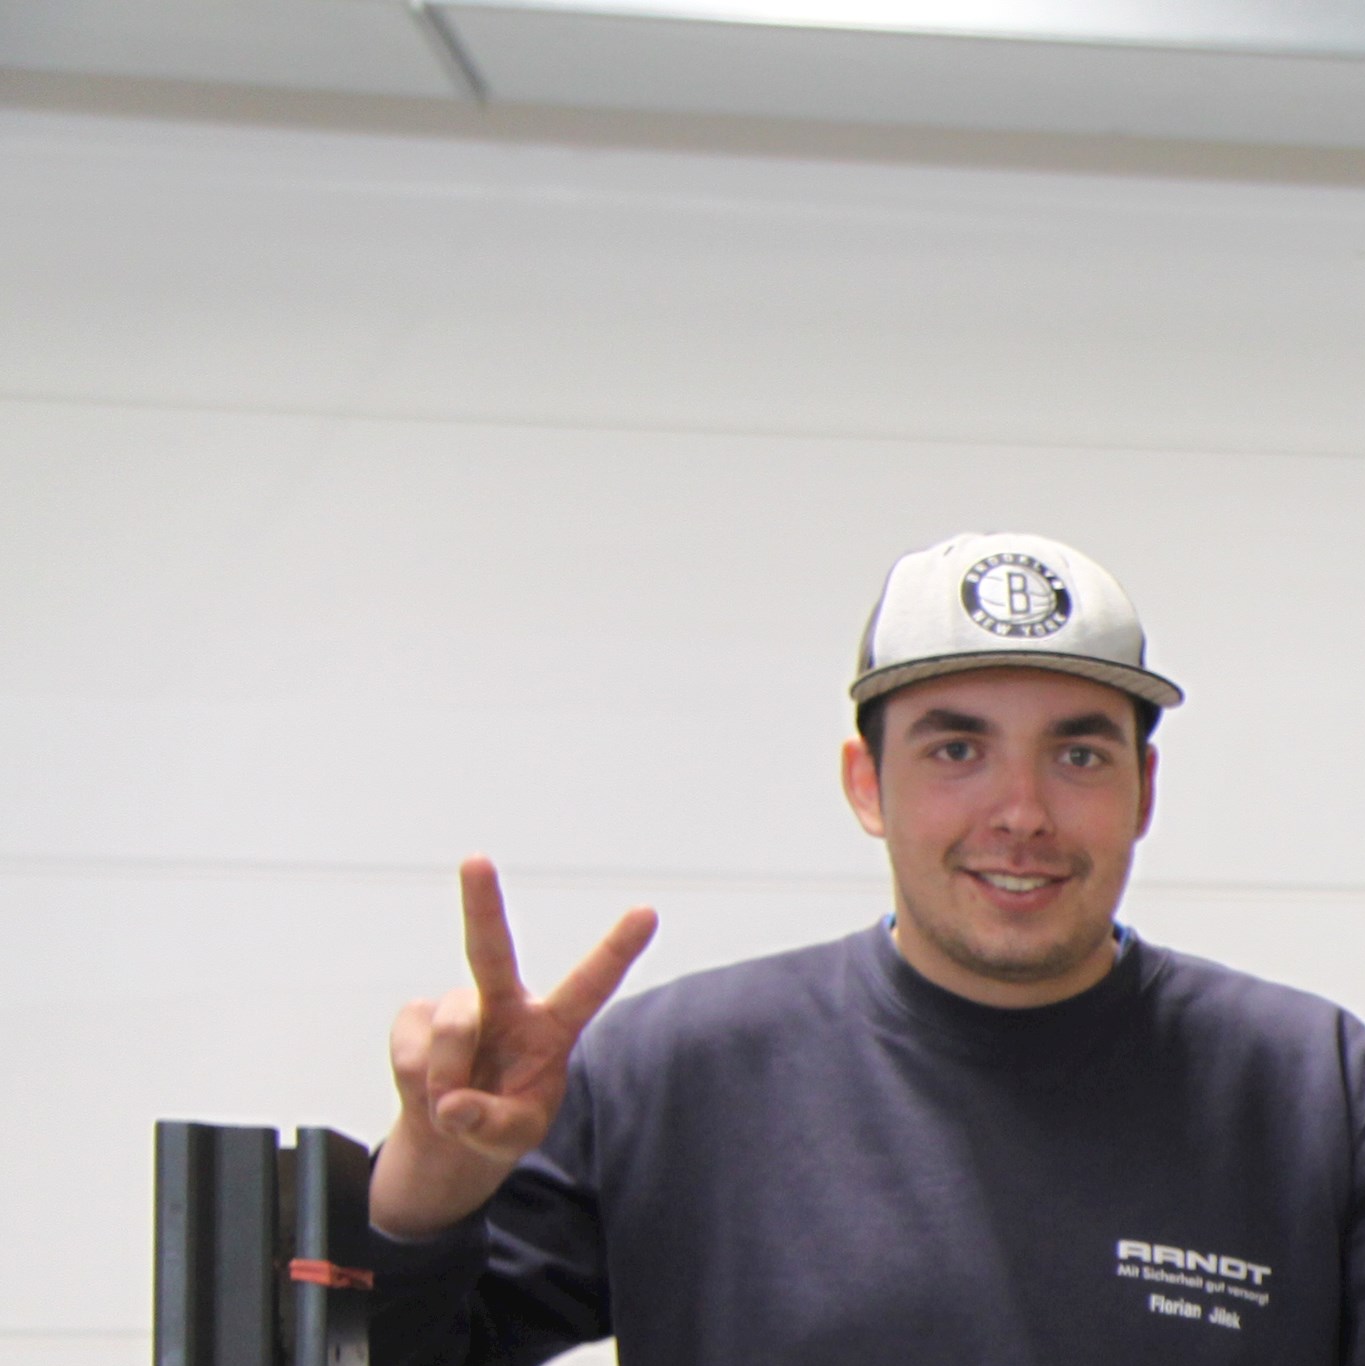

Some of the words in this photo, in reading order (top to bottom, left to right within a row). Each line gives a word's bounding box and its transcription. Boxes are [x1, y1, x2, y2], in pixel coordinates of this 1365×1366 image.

[965, 554, 1064, 590] BROOKLYN
[1006, 571, 1031, 615] B
[973, 611, 1011, 637] NEW
[1020, 612, 1067, 637] YORK
[1117, 1239, 1272, 1285] ARNDT
[1117, 1263, 1140, 1278] Mit
[1142, 1265, 1203, 1289] Sicherheit
[1204, 1280, 1225, 1294] gut
[1150, 1293, 1202, 1319] Florian
